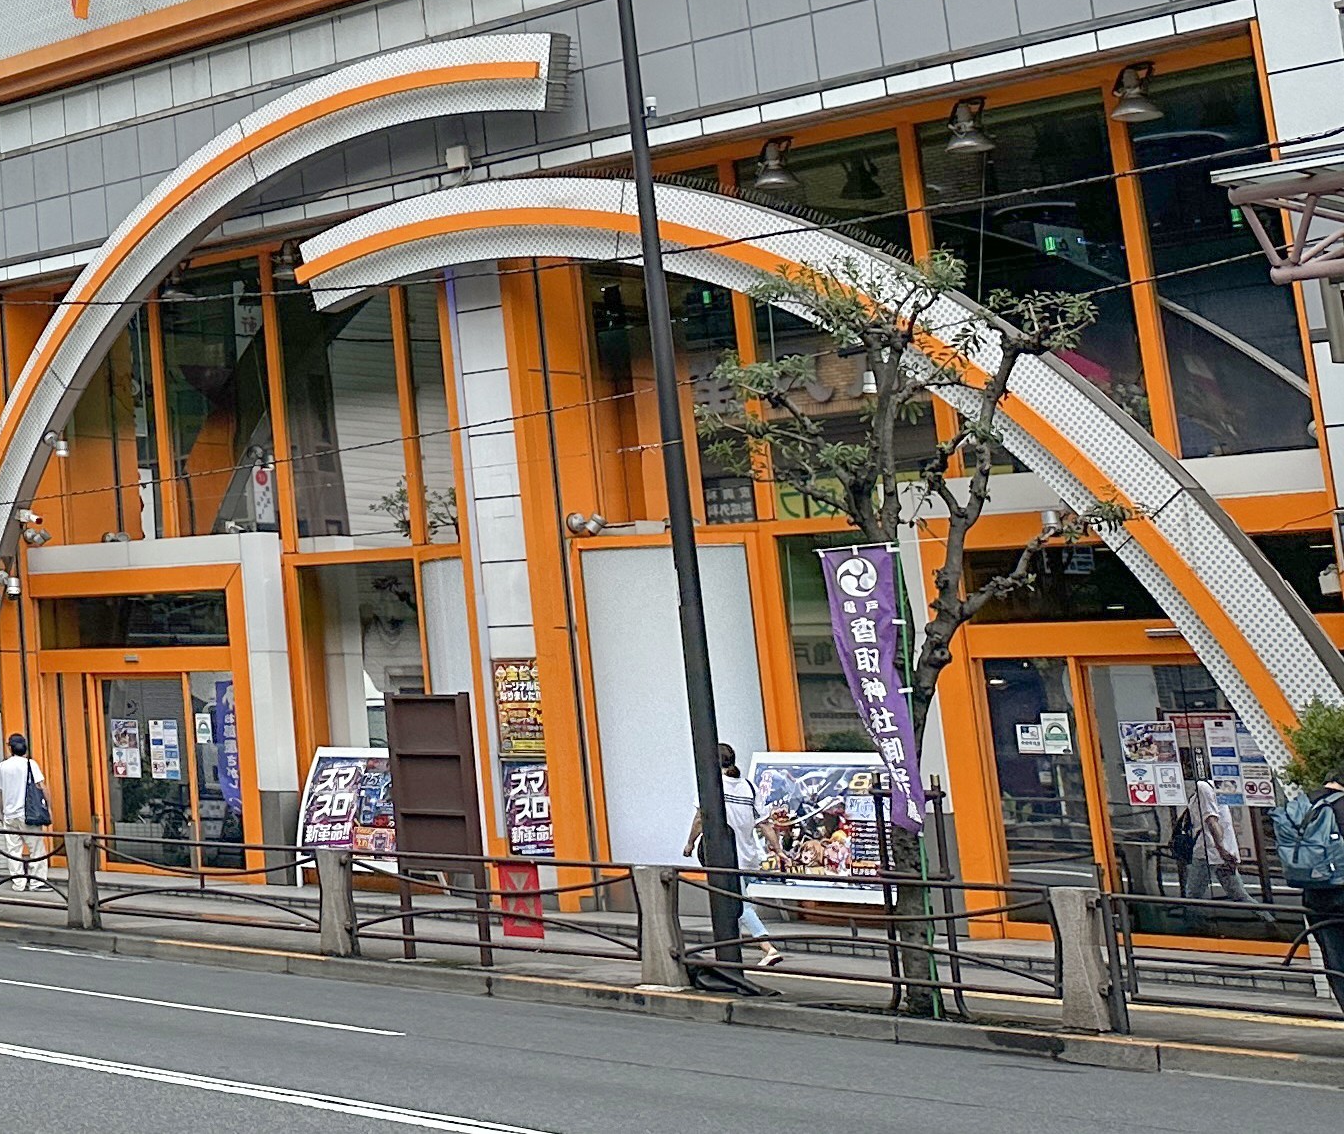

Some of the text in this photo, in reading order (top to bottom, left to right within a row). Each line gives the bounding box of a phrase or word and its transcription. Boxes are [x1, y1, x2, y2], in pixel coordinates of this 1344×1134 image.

[315, 767, 357, 793] スマ
[511, 771, 544, 795] スマ
[313, 793, 355, 822] スロ
[515, 796, 549, 823] スロ
